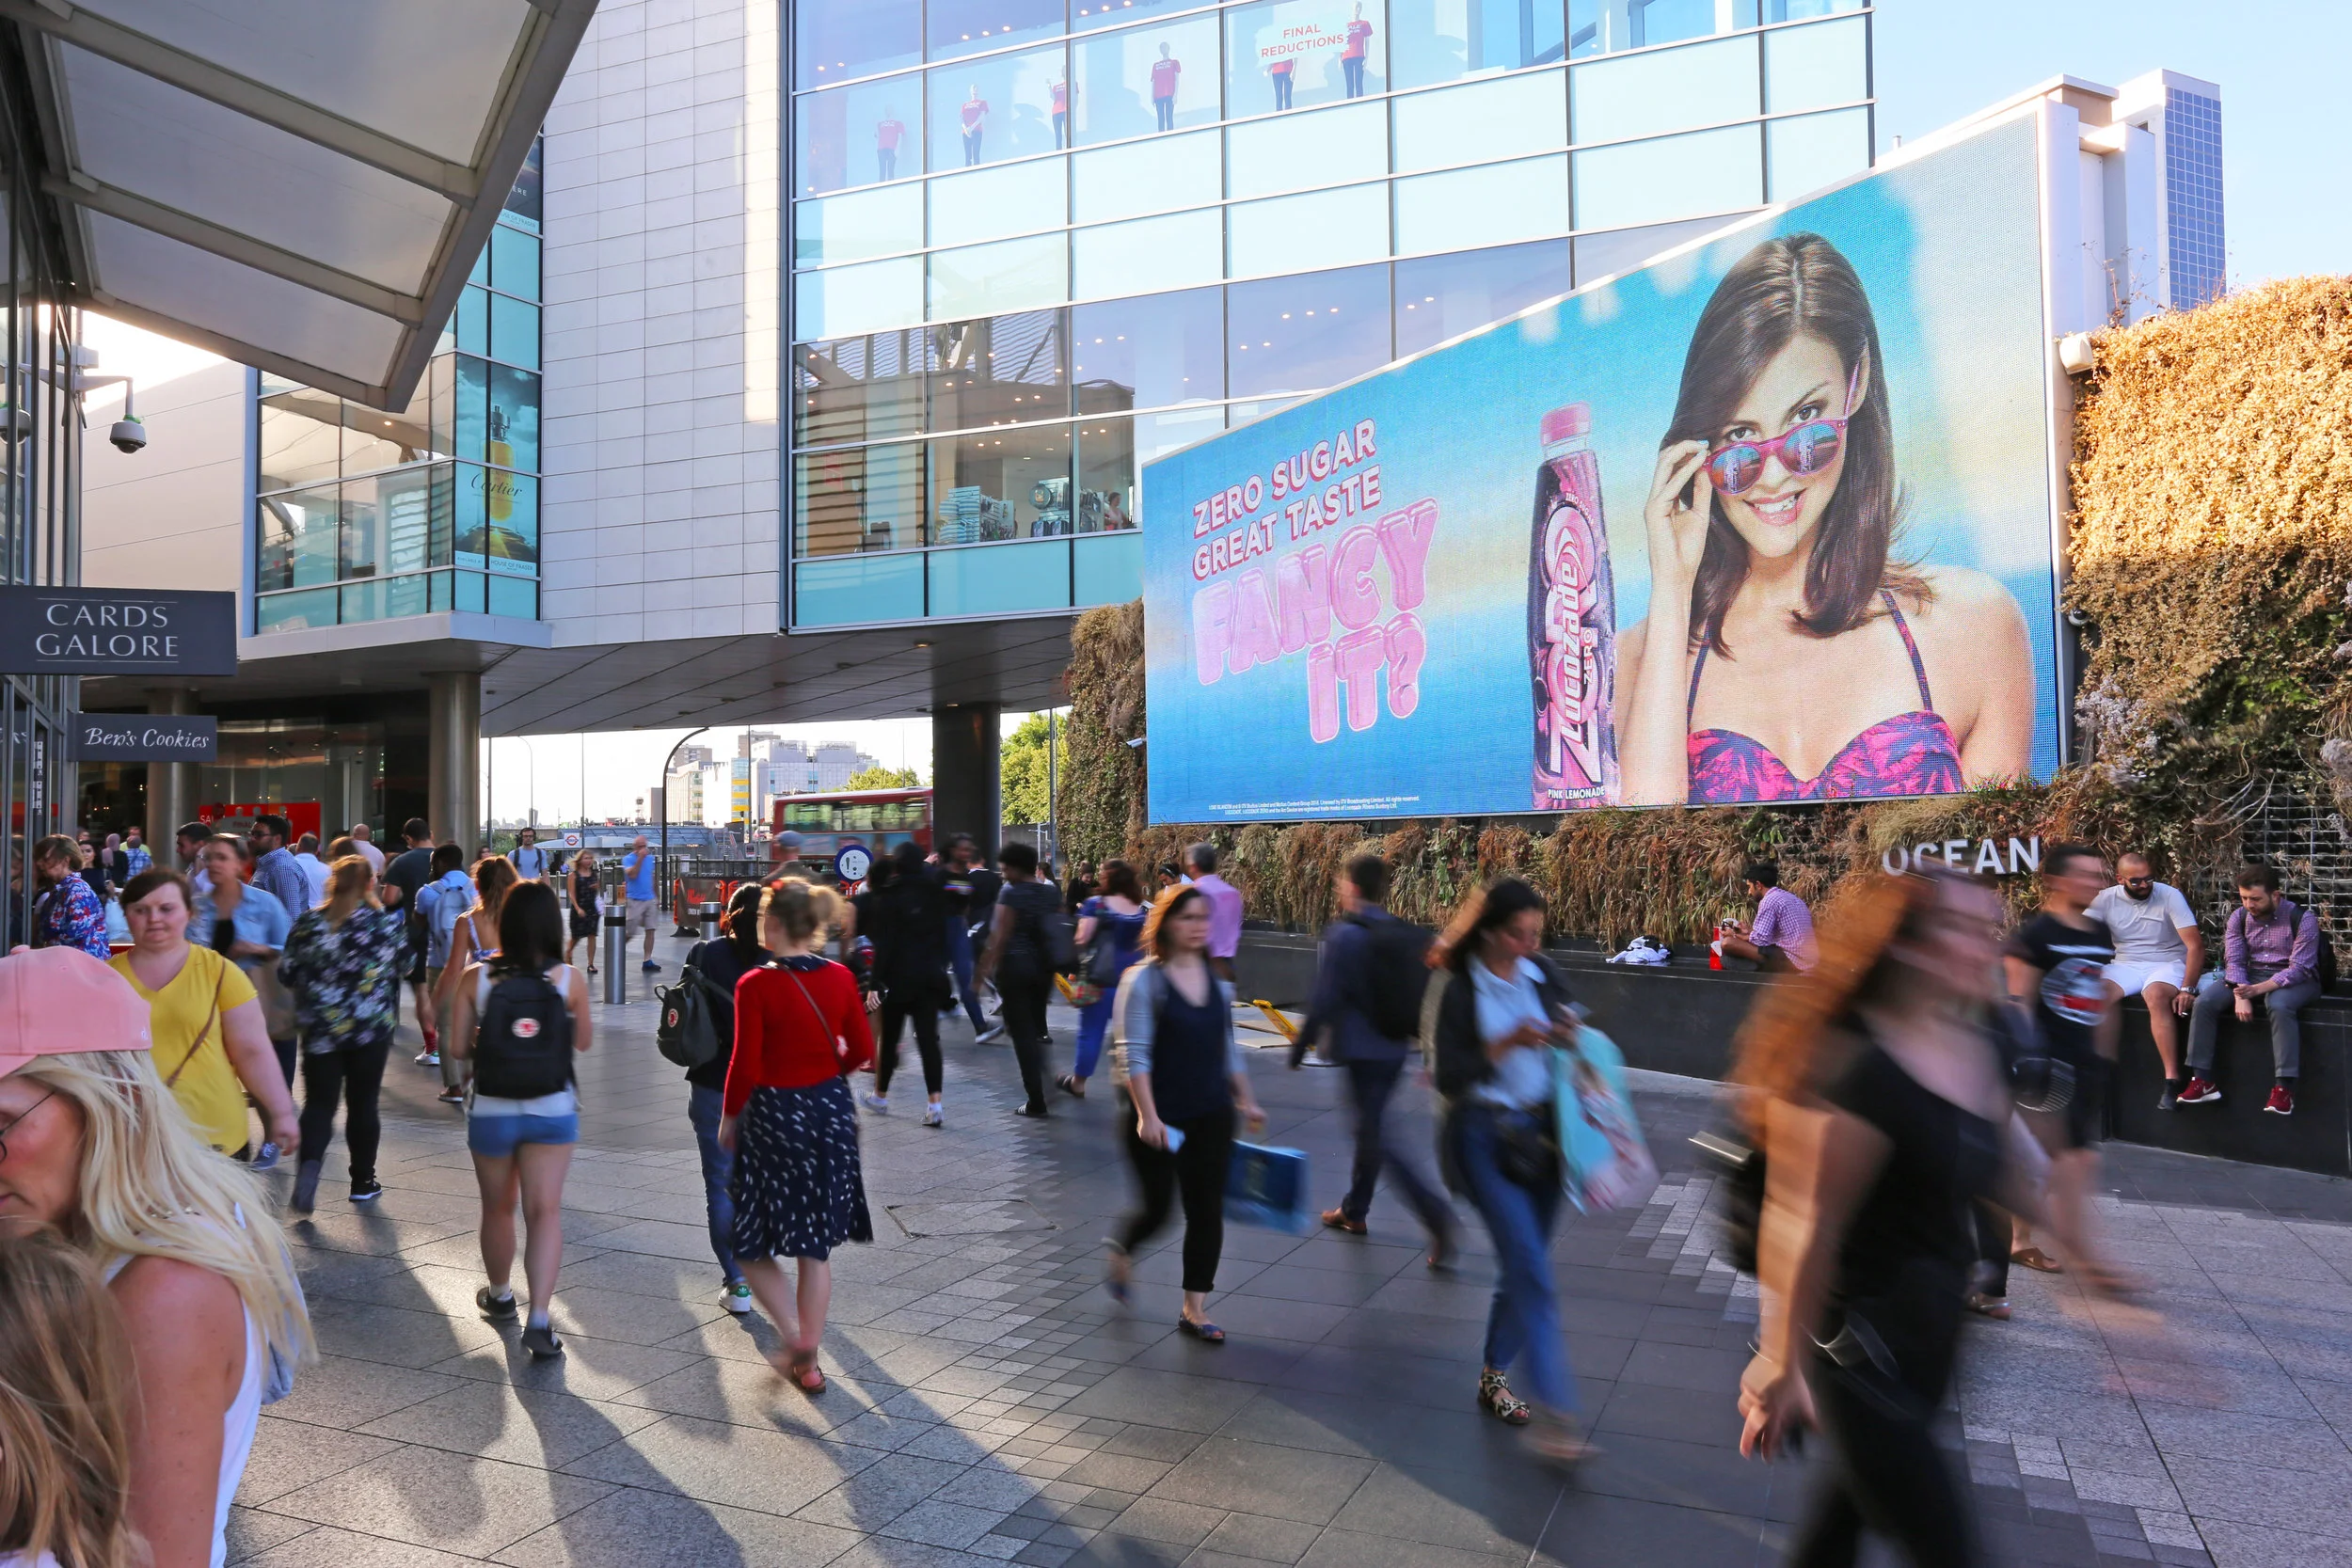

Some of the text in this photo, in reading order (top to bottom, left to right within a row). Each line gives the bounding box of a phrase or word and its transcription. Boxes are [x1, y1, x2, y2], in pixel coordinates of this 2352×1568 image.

[1261, 34, 1344, 58] REDUCTIONS
[1283, 24, 1321, 39] FINAL
[1193, 418, 1377, 539] ZERO SUGAR
[1193, 465, 1382, 581] GREAT TASTE
[1192, 497, 1439, 686] FANCY
[46, 603, 168, 628] CARDS
[36, 633, 179, 657] GALORE
[1557, 561, 1584, 744] Lucozade
[1582, 628, 1594, 686] ZERO
[1307, 611, 1426, 744] IT?
[85, 727, 210, 749] Ben's Cookies
[1548, 786, 1605, 800] PINK LEMONADE
[1883, 835, 2040, 877] OCEAN
